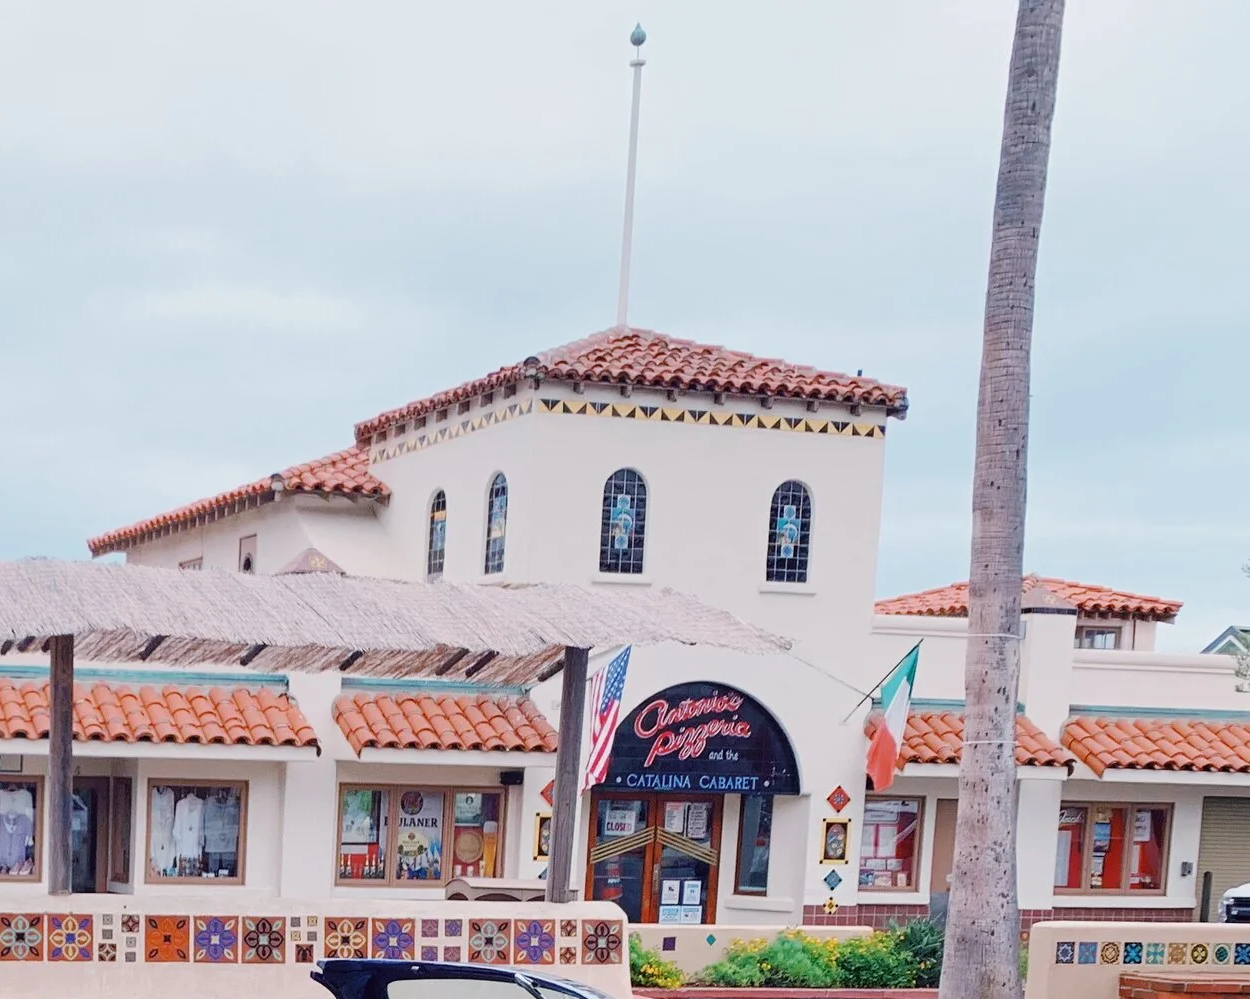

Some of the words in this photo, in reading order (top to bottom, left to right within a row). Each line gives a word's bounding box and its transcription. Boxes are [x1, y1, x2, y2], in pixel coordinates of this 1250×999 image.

[634, 690, 744, 739] Antonio's
[708, 748, 724, 761] and
[726, 748, 739, 761] the
[626, 773, 691, 789] CATALINA
[699, 775, 759, 790] CABARET
